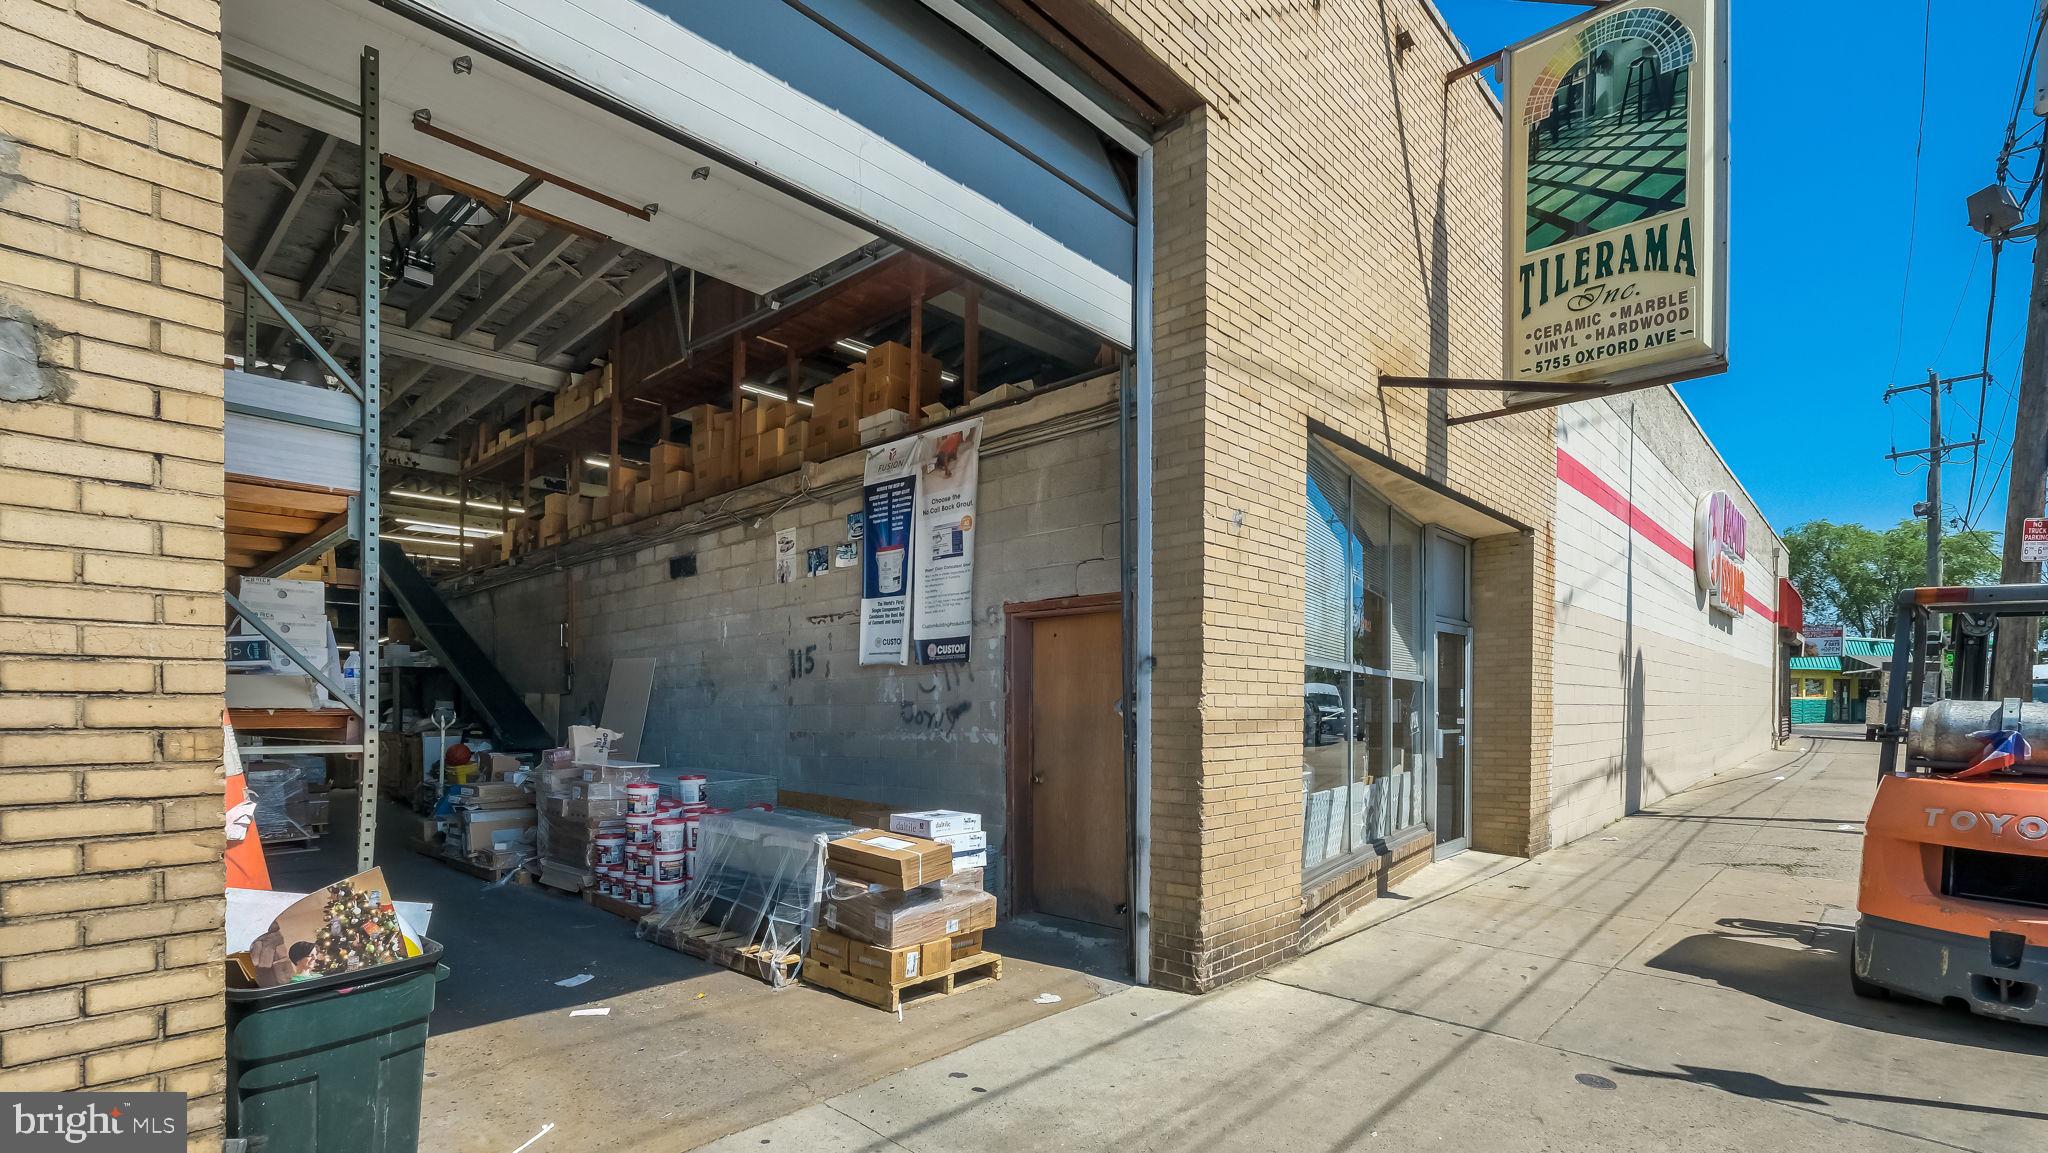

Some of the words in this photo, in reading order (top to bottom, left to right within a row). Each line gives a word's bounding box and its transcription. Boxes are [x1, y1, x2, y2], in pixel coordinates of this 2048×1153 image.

[1520, 217, 1696, 320] TILERAMA
[1567, 283, 1640, 311] Inc.
[1533, 312, 1602, 340] CERAMIC
[1620, 290, 1688, 319] MARBLE
[1535, 335, 1578, 355] VINYL
[1595, 307, 1689, 340] HARDWOOD
[1535, 354, 1571, 373] 5755
[1575, 338, 1639, 363] OXFORD
[1644, 329, 1676, 348] AVE
[877, 460, 904, 472] FUSION
[931, 495, 951, 505] Choose
[937, 642, 966, 654] CUSTOM
[896, 820, 917, 832] daltile
